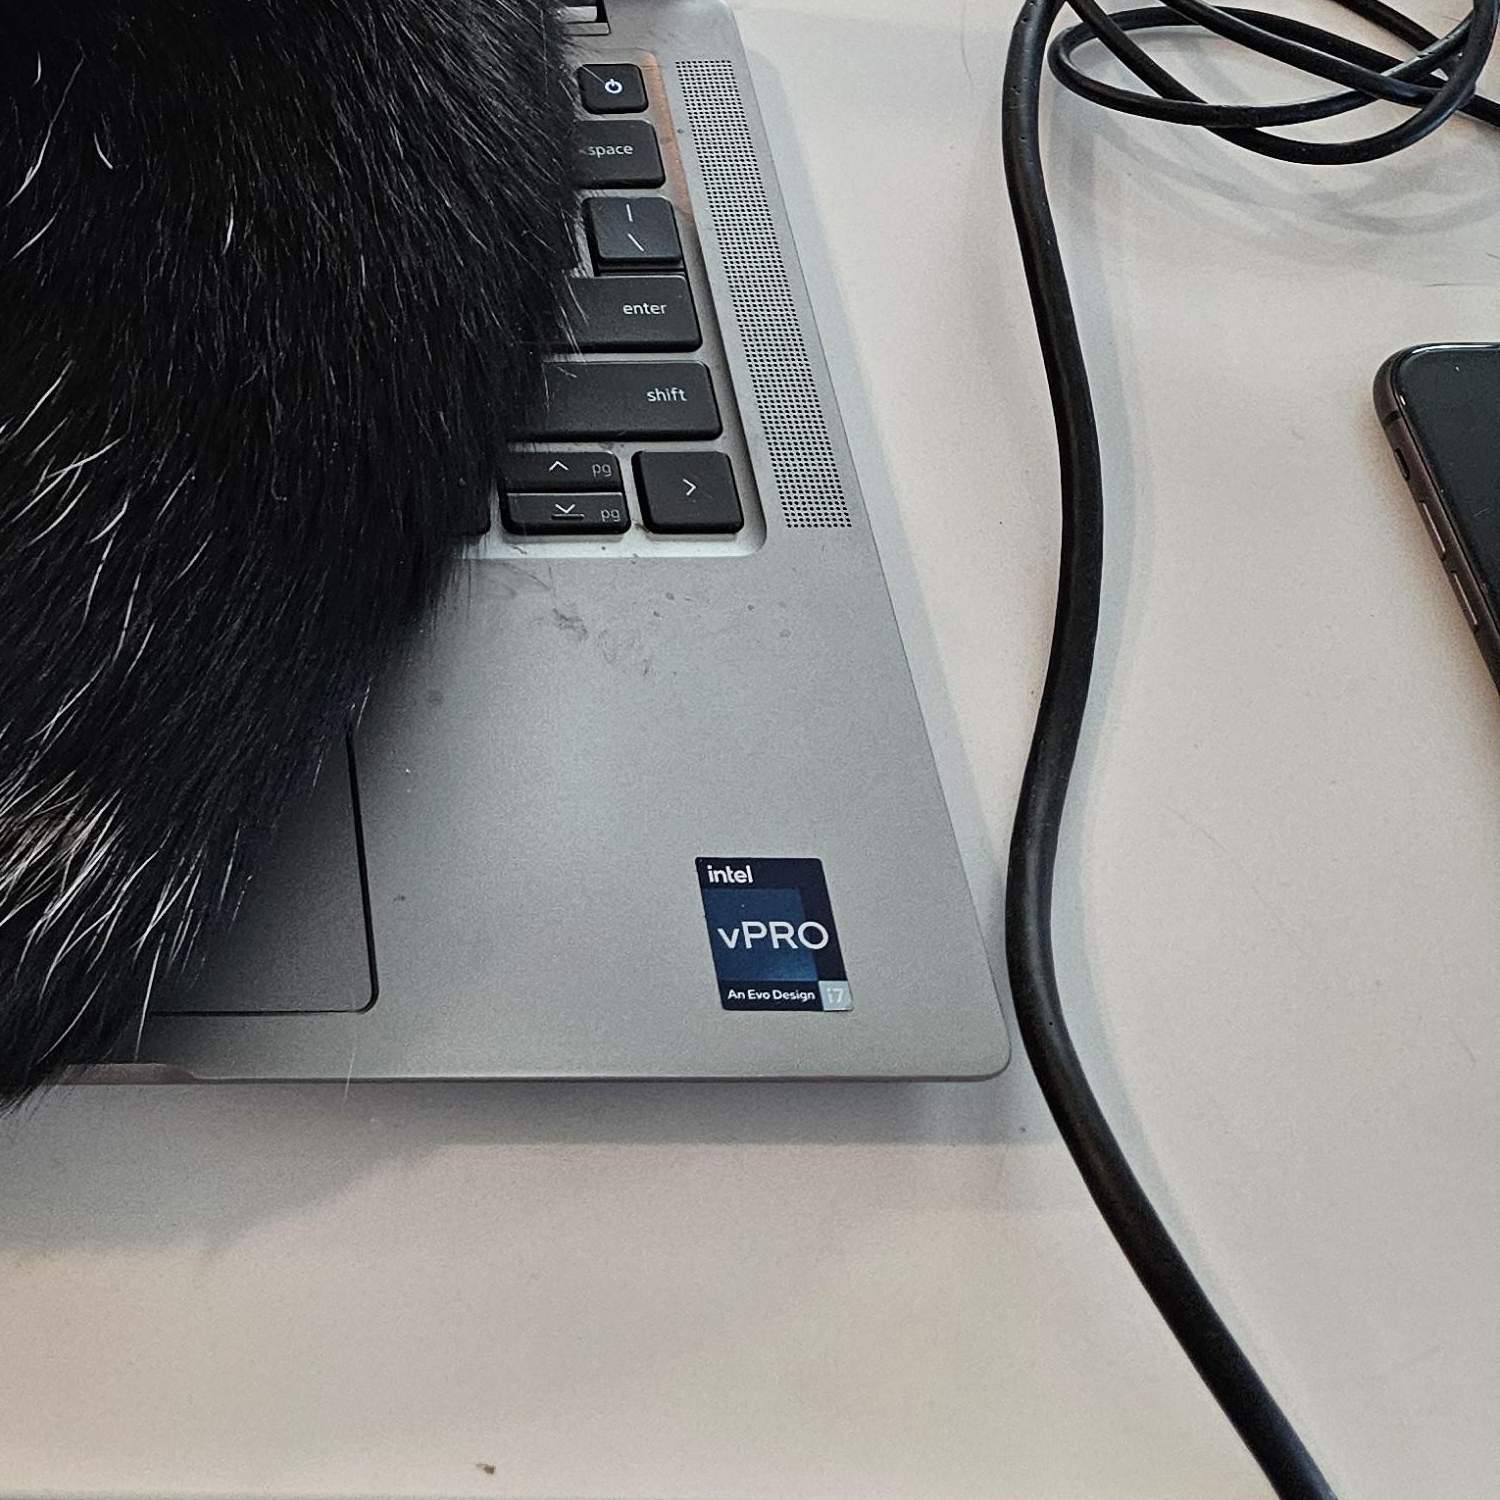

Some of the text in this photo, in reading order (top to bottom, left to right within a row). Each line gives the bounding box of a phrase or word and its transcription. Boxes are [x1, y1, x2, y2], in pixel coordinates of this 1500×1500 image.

[580, 145, 634, 159] space
[622, 302, 667, 314] enter
[646, 387, 687, 402] shift
[592, 463, 612, 477] pg
[601, 509, 621, 522] pg
[707, 865, 754, 883] intel
[717, 921, 829, 950] vPRO
[727, 989, 816, 1002] An Evo Design
[827, 988, 844, 1003] i7
